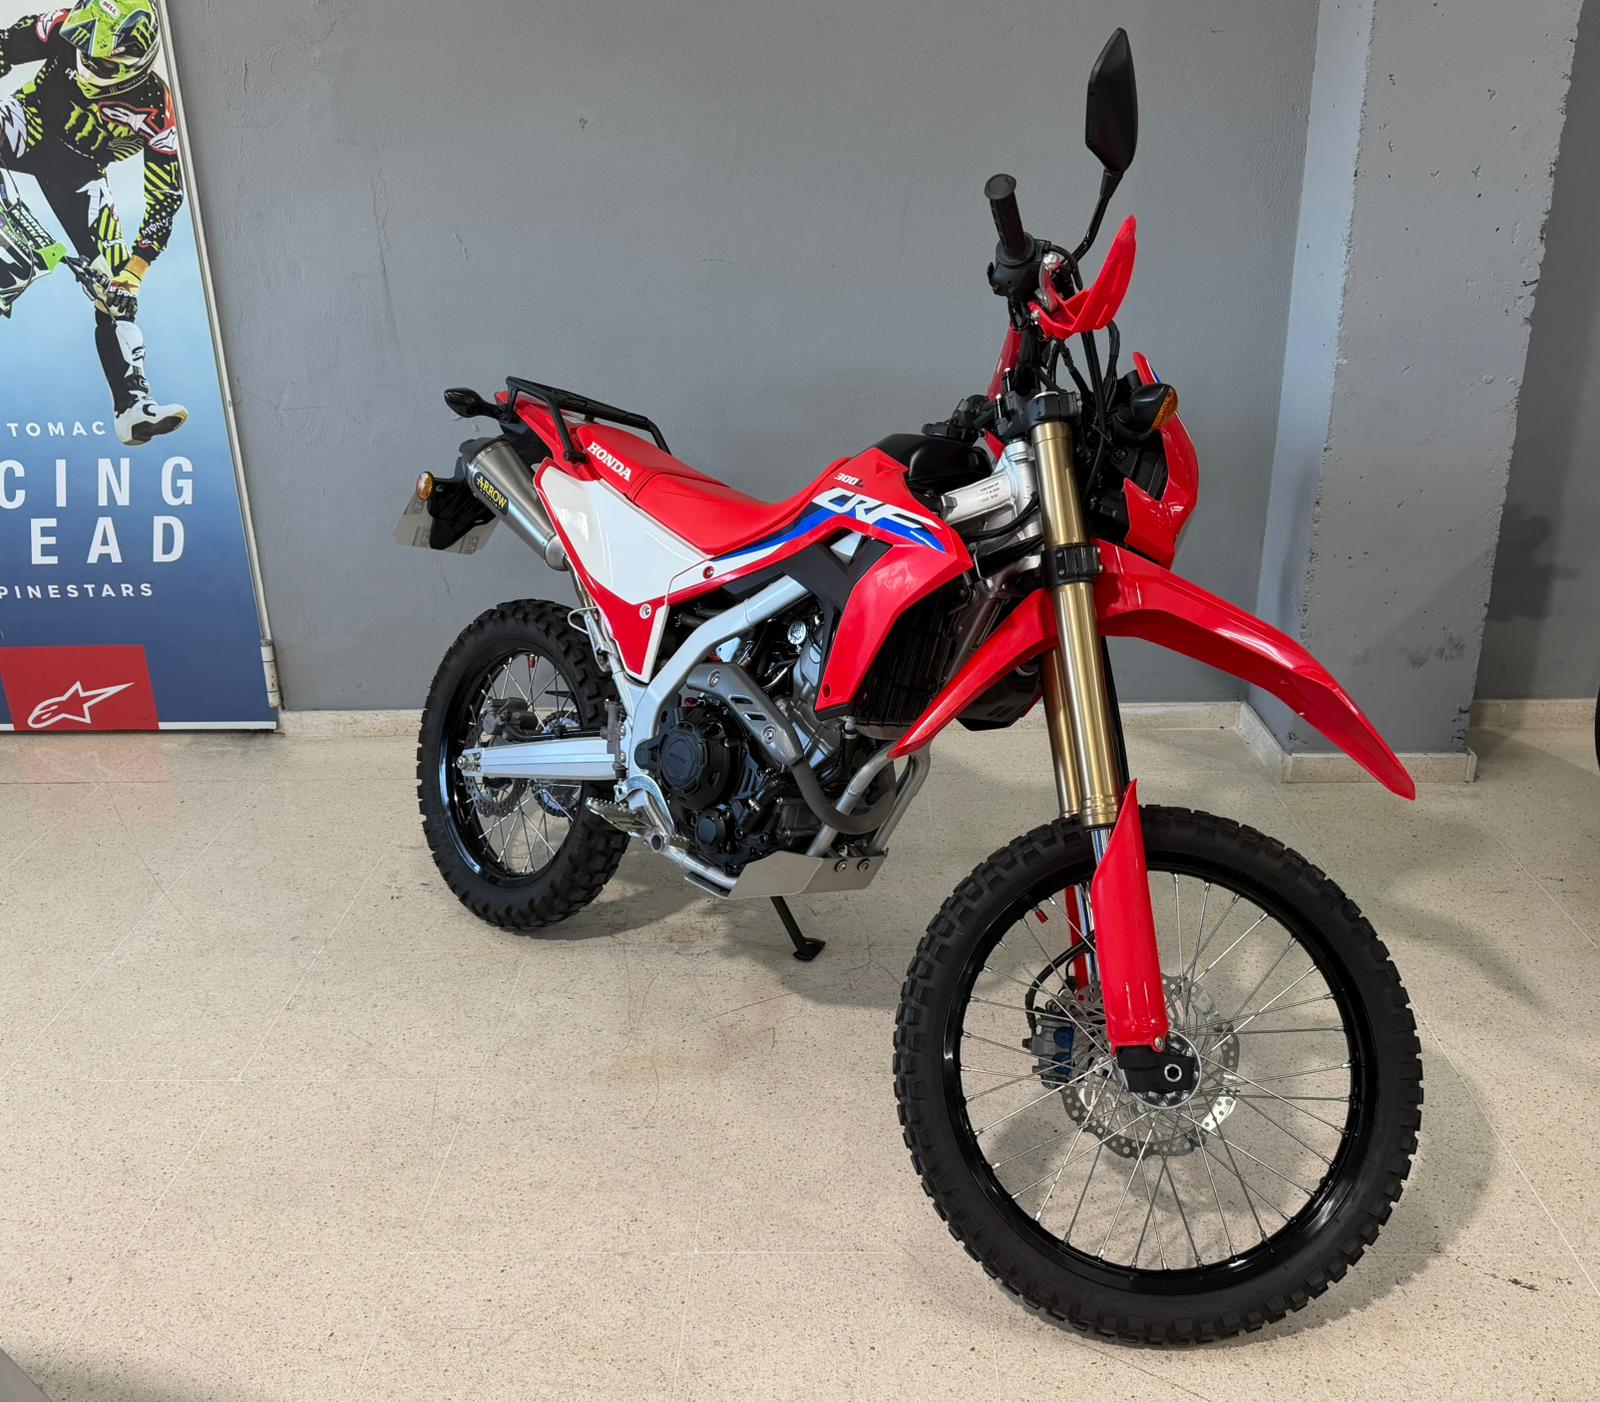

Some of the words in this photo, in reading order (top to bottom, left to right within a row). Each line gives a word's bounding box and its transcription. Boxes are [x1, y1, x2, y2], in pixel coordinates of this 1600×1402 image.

[102, 1, 117, 14] BELL
[7, 421, 106, 438] TOMAC
[586, 441, 632, 481] HONDA
[0, 456, 193, 509] CING
[476, 475, 508, 509] ARROW
[812, 487, 942, 530] CRF
[30, 515, 185, 565] EAD
[0, 583, 153, 599] PINESTARS
